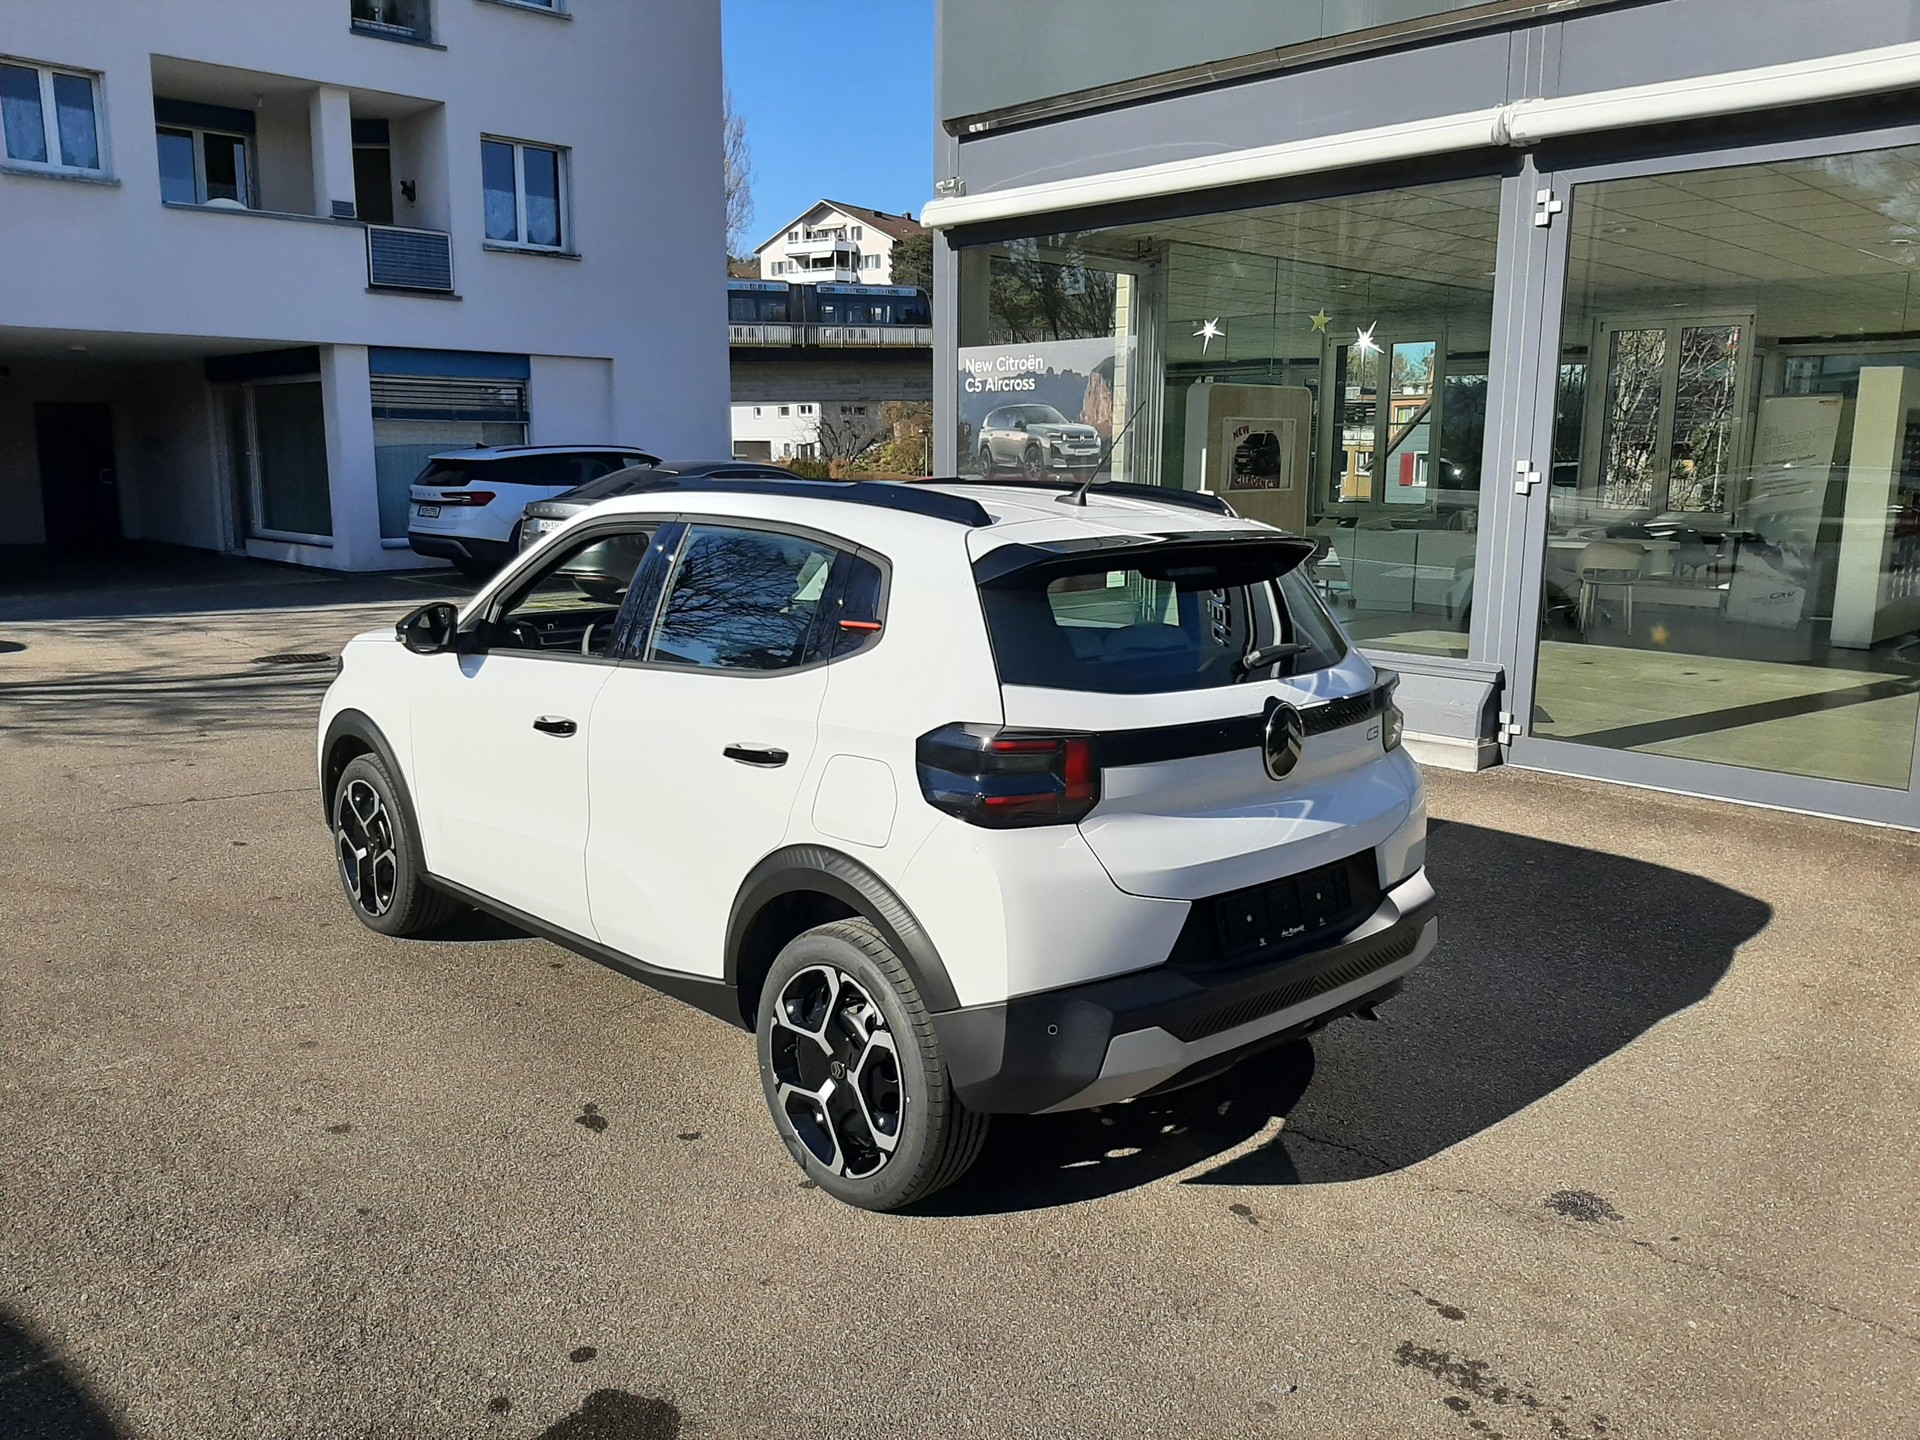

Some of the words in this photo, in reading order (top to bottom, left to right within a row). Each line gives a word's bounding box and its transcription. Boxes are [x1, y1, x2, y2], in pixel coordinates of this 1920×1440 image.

[965, 358, 993, 374] New
[996, 354, 1044, 371] Citroën
[965, 378, 982, 393] C5
[985, 377, 1036, 392] Aircross
[1233, 425, 1250, 440] NEW
